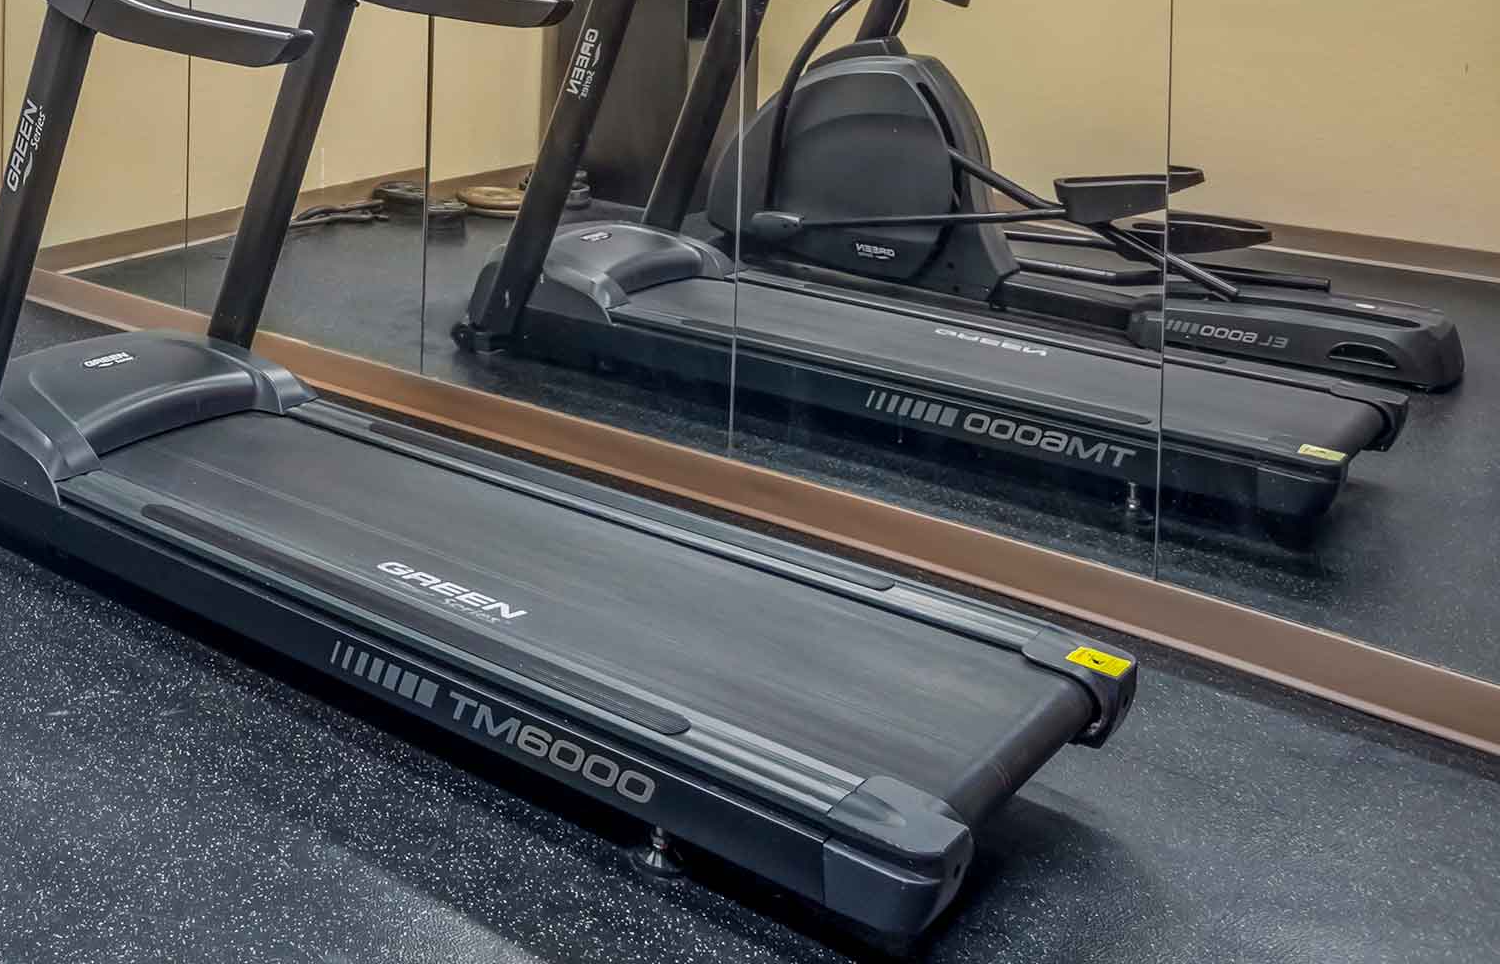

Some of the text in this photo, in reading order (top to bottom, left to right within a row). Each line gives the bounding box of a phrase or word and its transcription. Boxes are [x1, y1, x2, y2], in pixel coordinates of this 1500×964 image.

[7, 98, 38, 192] GREEN
[30, 111, 46, 150] Series
[376, 561, 528, 619] GREEN
[449, 691, 656, 804] TM6000
